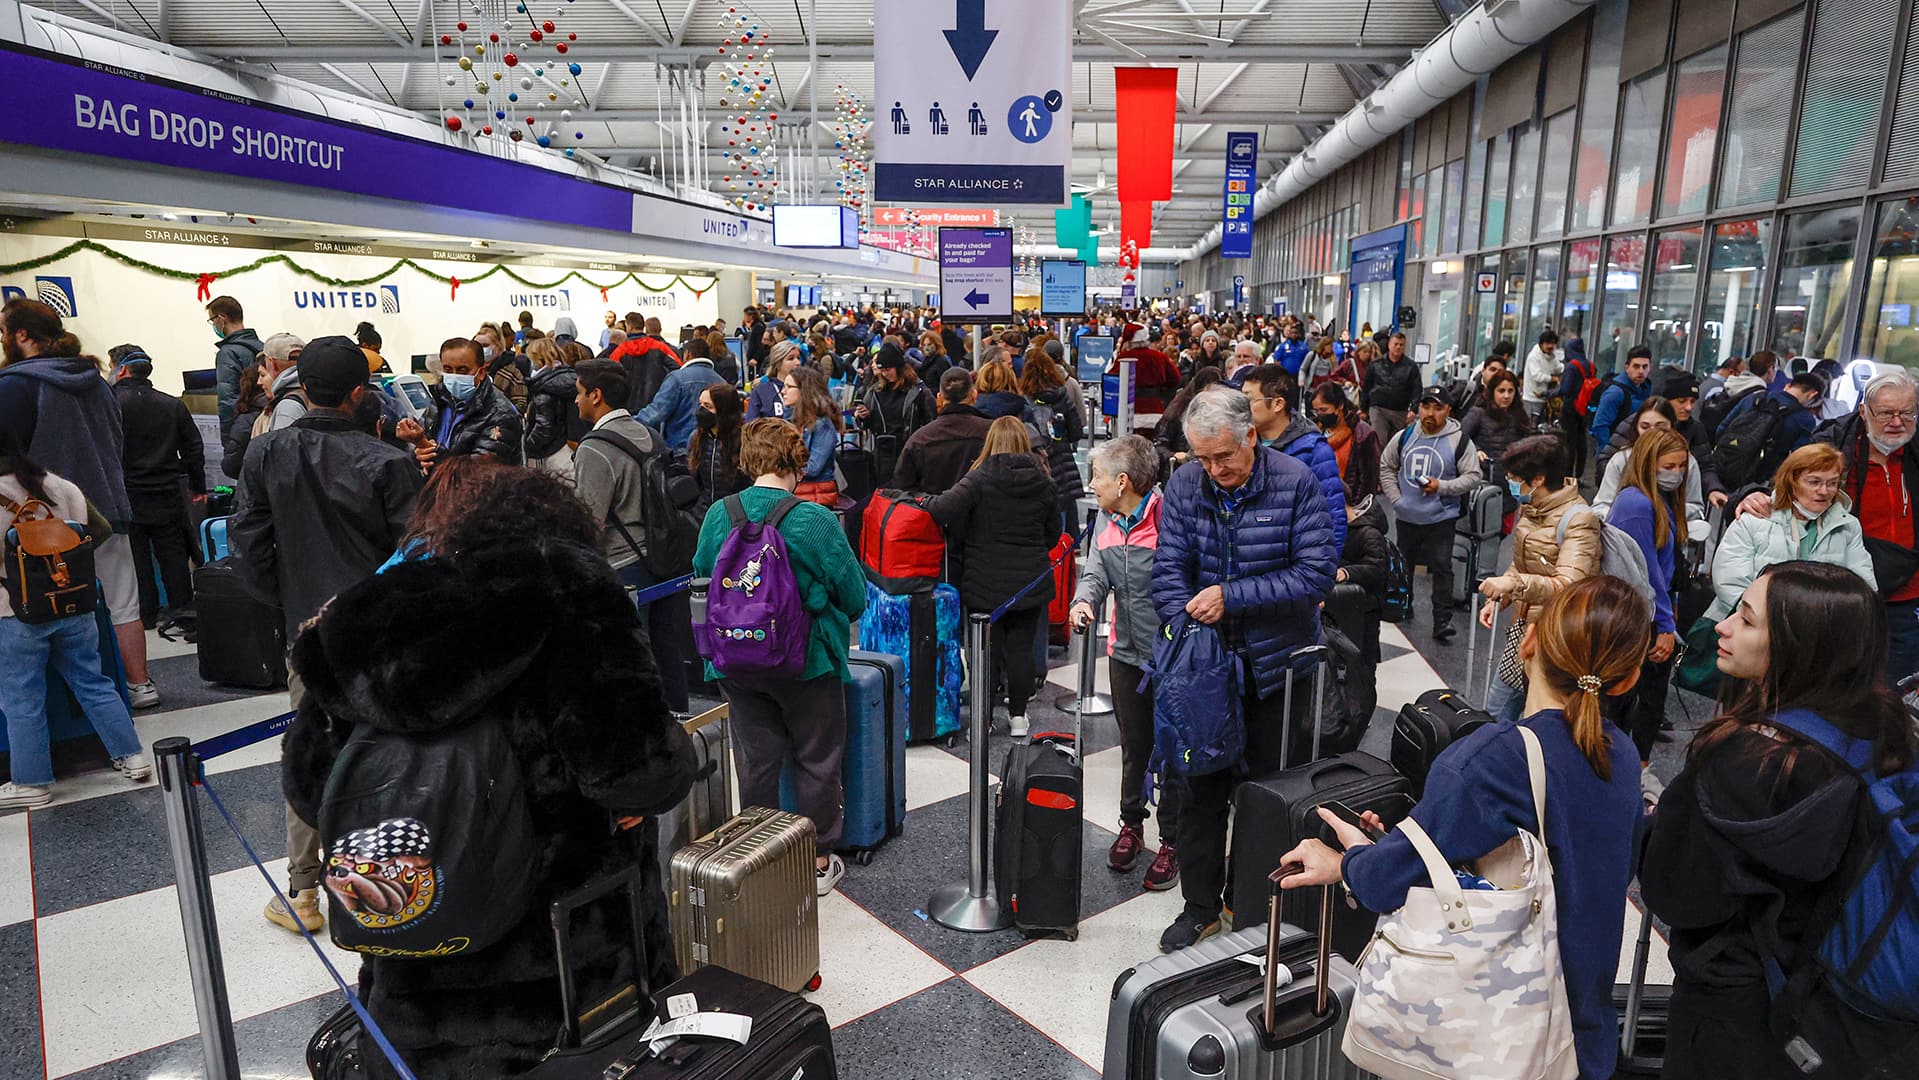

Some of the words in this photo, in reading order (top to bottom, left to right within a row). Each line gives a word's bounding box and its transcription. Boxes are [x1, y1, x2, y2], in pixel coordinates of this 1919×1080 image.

[84, 61, 103, 71] STAR
[105, 64, 138, 80] ALLIANCE
[74, 94, 140, 137] BAG
[150, 108, 225, 149] DROP
[232, 125, 345, 171] SHORTCUT
[914, 178, 945, 189] STAR
[949, 178, 1009, 190] ALLIANCE
[1230, 181, 1238, 190] 2
[1230, 195, 1237, 203] 3
[944, 213, 980, 222] Entrance
[982, 213, 986, 222] 1
[1229, 208, 1236, 217] 5
[703, 218, 738, 238] UNITED
[144, 230, 171, 241] STAR
[173, 231, 219, 245] ALLIANCE
[314, 242, 332, 251] STAR
[334, 244, 366, 254] ALLIANCE
[294, 291, 377, 309] UNITED
[510, 294, 557, 308] UNITED
[636, 296, 668, 307] UNITED
